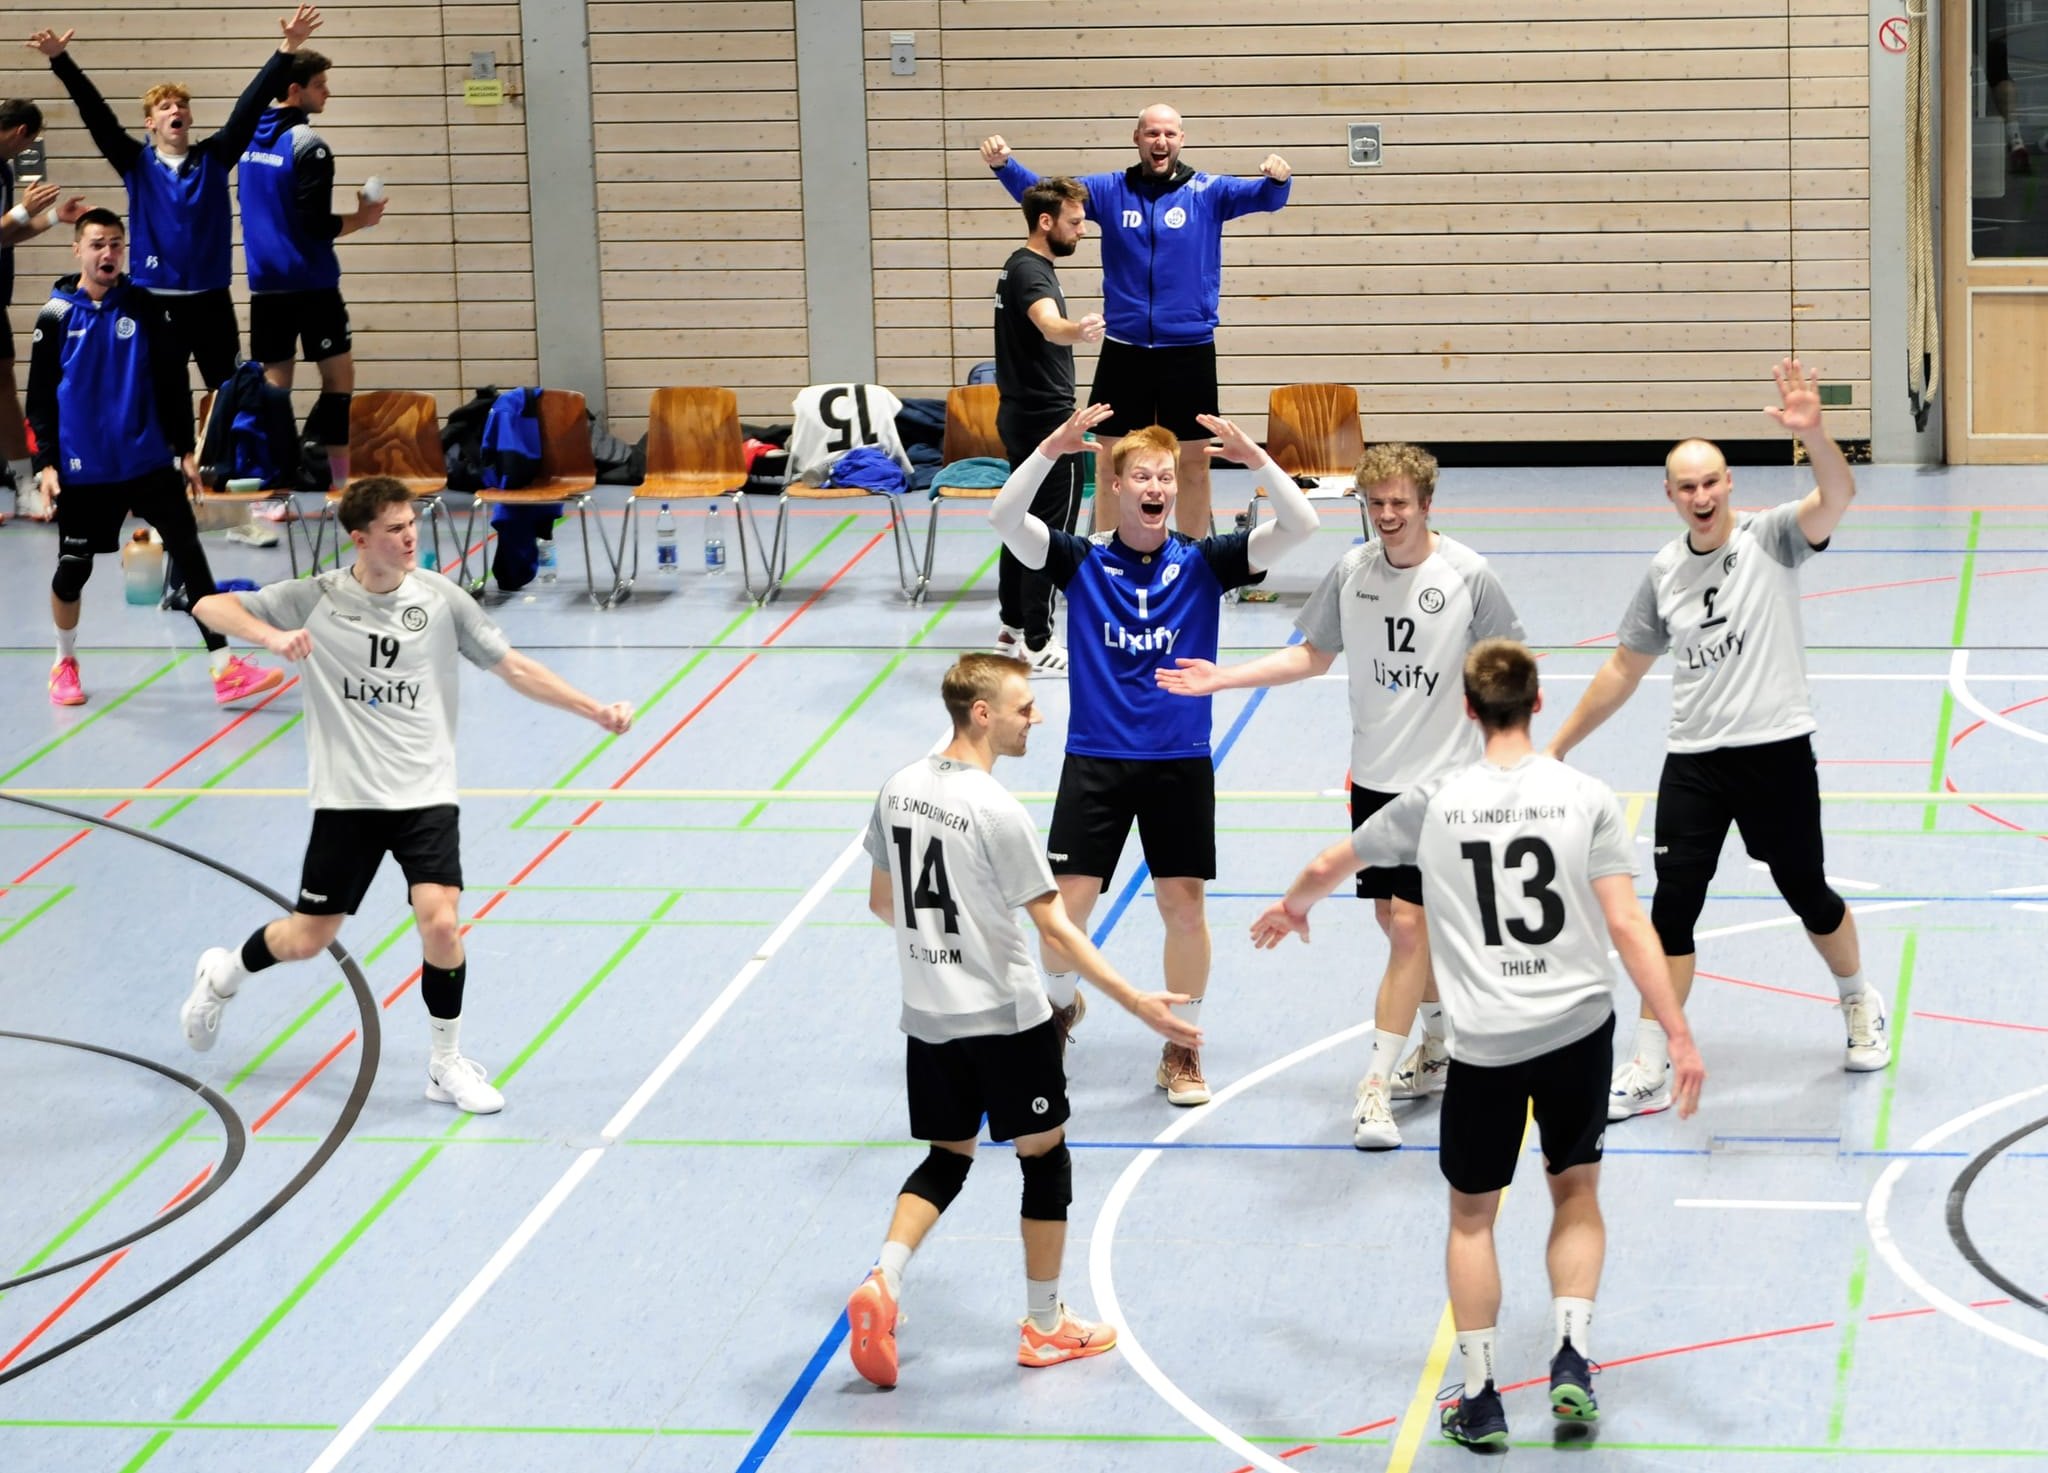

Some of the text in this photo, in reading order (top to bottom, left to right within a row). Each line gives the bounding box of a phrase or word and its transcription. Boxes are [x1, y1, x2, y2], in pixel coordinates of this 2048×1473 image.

[1122, 210, 1142, 228] TD
[819, 384, 879, 453] 15
[1135, 588, 1149, 618] 1
[367, 633, 400, 669] 19
[1104, 621, 1181, 656] Lixify
[1384, 615, 1416, 653] 12
[343, 676, 420, 710] Lixify
[1373, 658, 1440, 697] Lixify
[1444, 808, 1467, 825] VFL
[892, 825, 960, 936] 14
[1460, 836, 1566, 946] 13
[1500, 957, 1548, 977] THIEM
